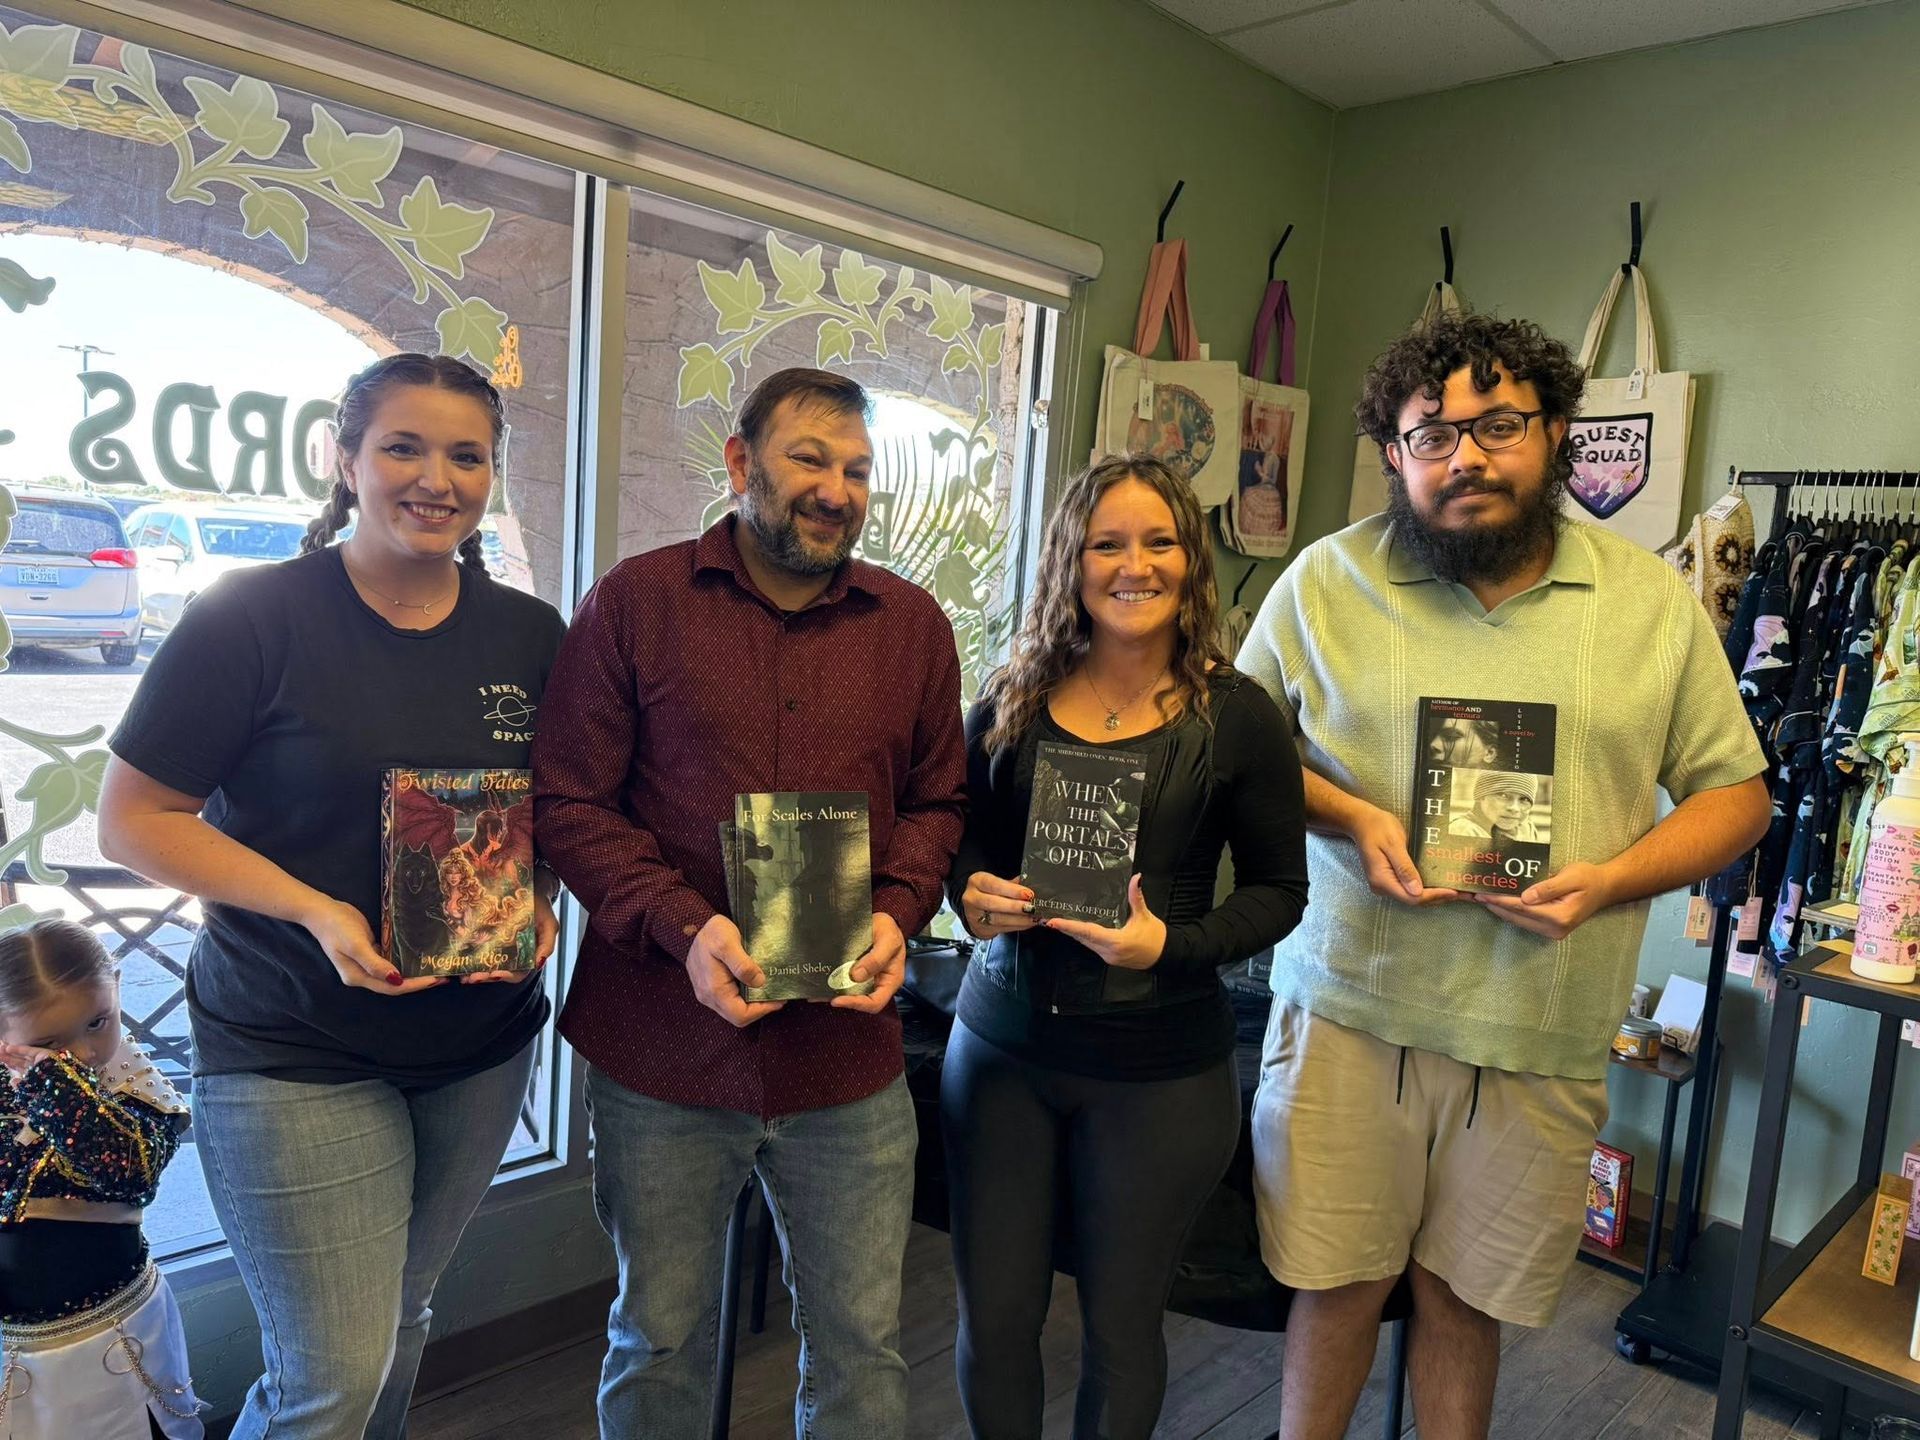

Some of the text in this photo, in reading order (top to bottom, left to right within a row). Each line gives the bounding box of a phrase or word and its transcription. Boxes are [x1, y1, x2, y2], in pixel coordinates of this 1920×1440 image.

[1571, 426, 1644, 448] QUEST
[1571, 449, 1641, 464] SQUAD
[478, 684, 527, 699] I NEED
[1465, 706, 1482, 714] AND
[492, 730, 535, 742] SPAC
[1527, 730, 1536, 738] by
[1058, 748, 1089, 758] MIRRORED
[1108, 755, 1126, 764] BOOK
[398, 773, 530, 791] Twisted Tales
[1055, 780, 1122, 805] WHEN
[743, 806, 857, 823] For Scales Alone
[1067, 806, 1100, 822] THE
[1424, 769, 1445, 845] THE
[1032, 820, 1129, 851] PORTALS
[1049, 845, 1105, 871] OPEN
[1875, 849, 1897, 857] BODY
[1426, 846, 1541, 878] smallest OF
[1446, 870, 1518, 890] mercies
[1075, 904, 1119, 918] KOEFOED
[421, 952, 508, 969] Megan Rico
[769, 965, 800, 977] Daniel
[802, 961, 832, 975] Sheley
